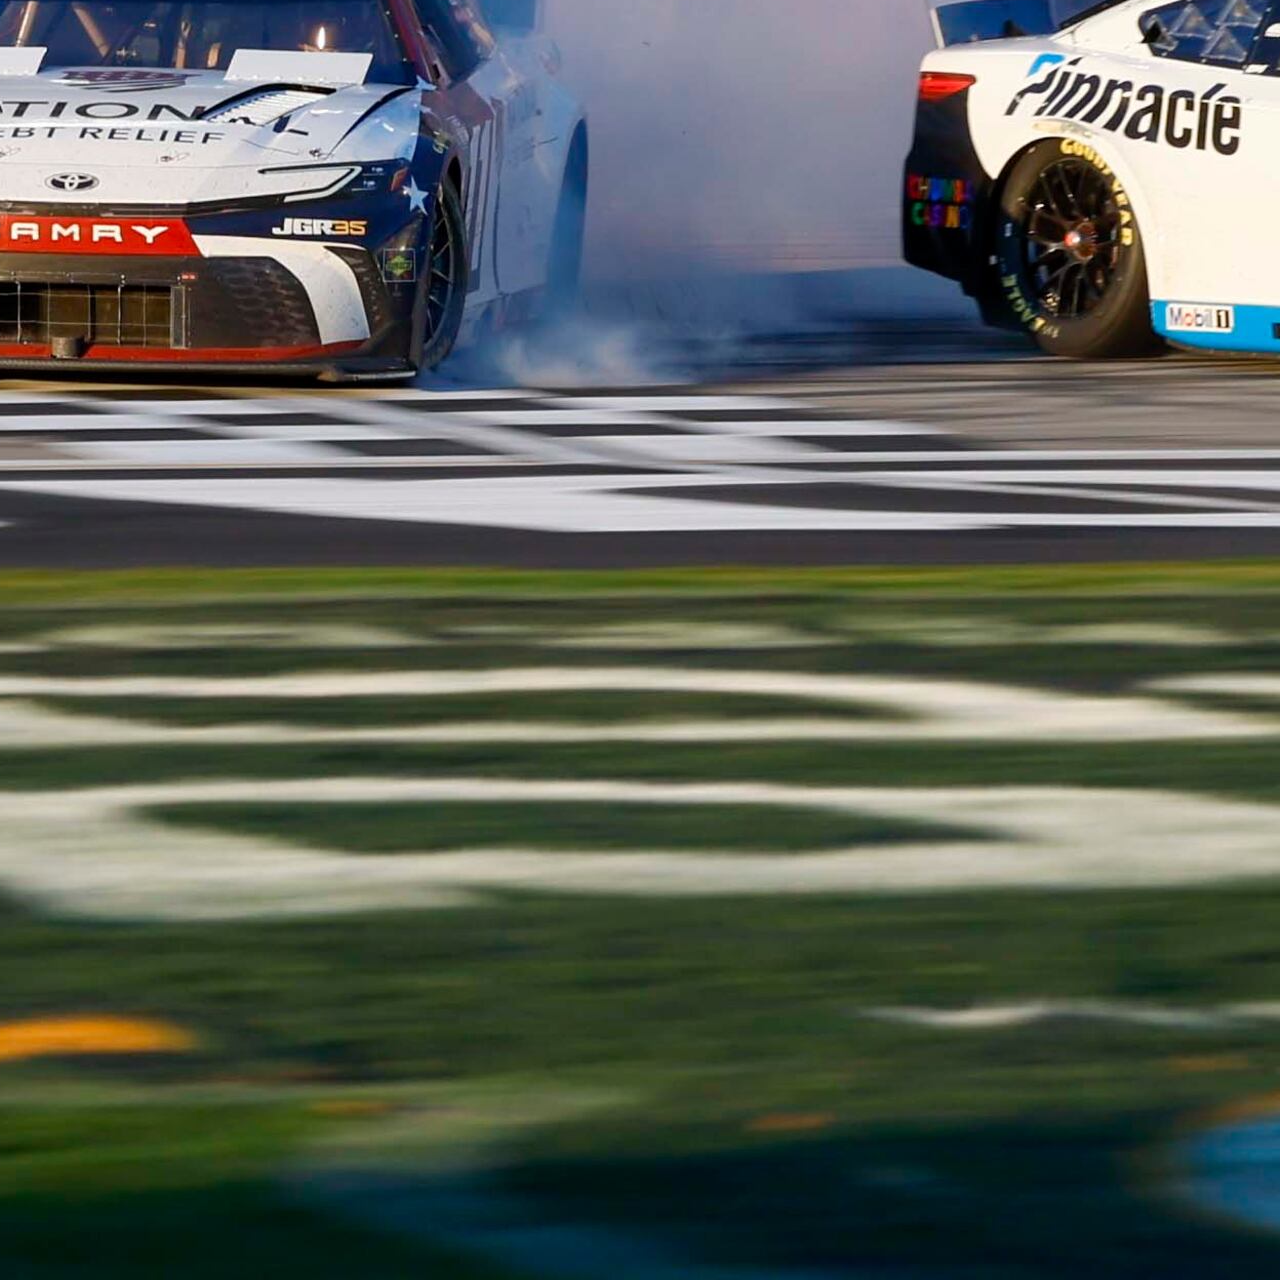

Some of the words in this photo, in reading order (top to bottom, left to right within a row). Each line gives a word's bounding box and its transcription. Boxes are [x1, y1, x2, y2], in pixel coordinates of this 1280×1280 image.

[1004, 52, 1241, 156] Pinnacle
[79, 126, 225, 145] RELIEF
[272, 217, 368, 237] JGR35
